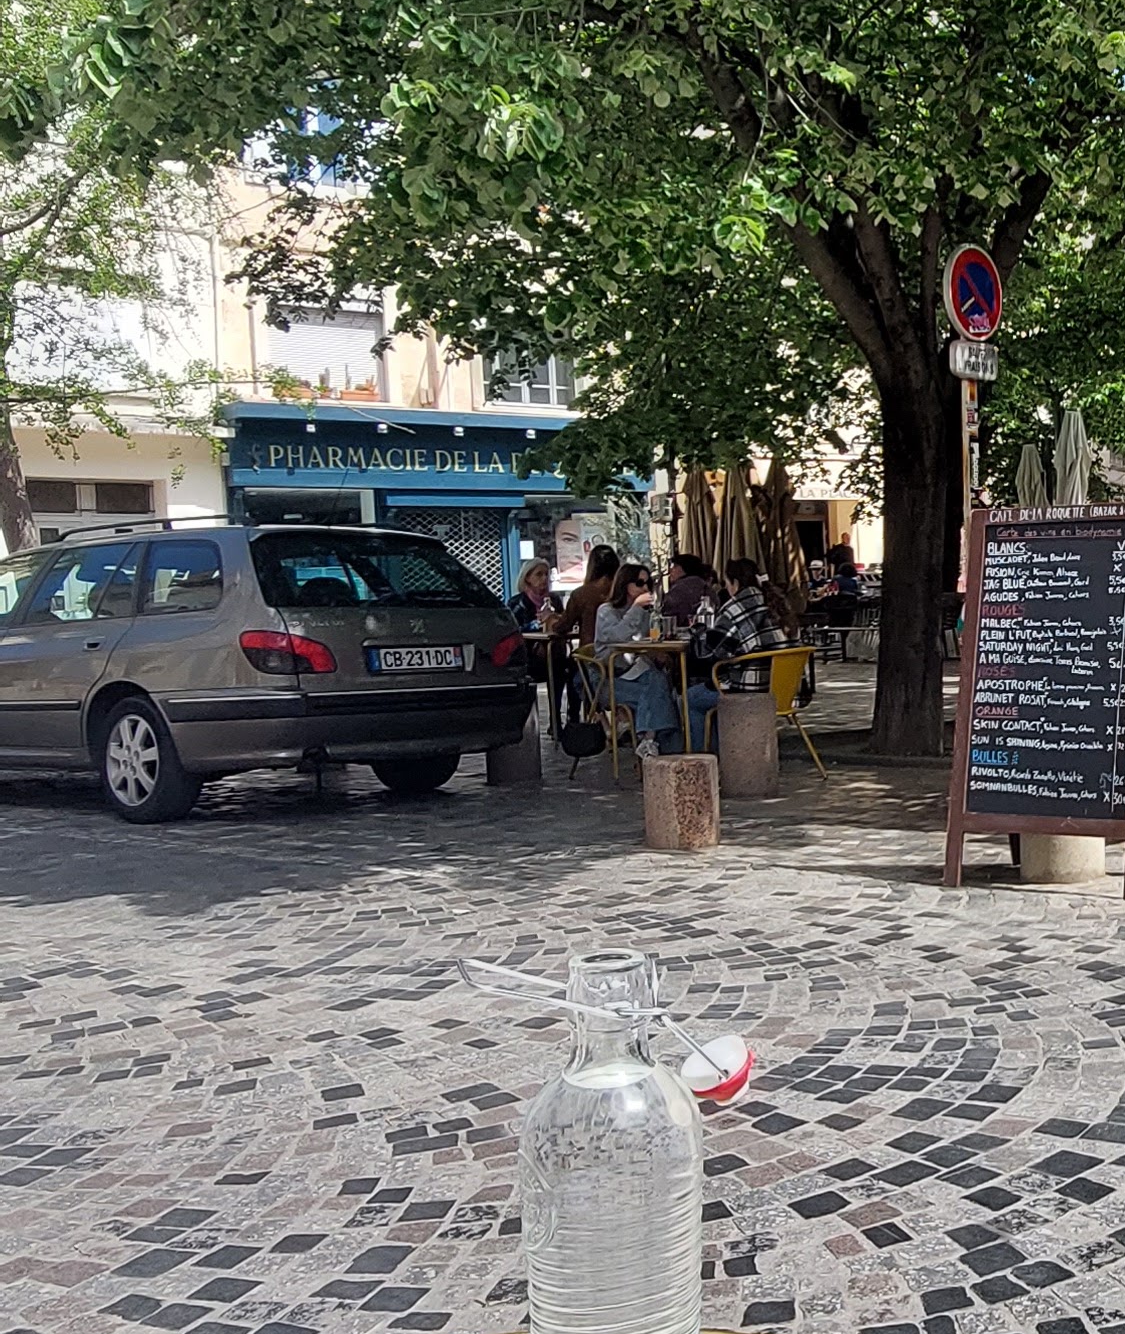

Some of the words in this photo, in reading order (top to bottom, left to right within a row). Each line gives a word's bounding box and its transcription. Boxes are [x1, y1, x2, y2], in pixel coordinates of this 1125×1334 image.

[268, 444, 427, 473] PHARMACIE
[434, 449, 468, 473] DE
[474, 451, 505, 474] LA
[800, 489, 815, 499] LA
[1046, 506, 1086, 520] ROQUETTE
[996, 527, 1019, 537] Carte
[1025, 527, 1038, 537] des
[982, 604, 1026, 616] ROUGES
[980, 629, 1005, 640] PLEIN
[979, 641, 1024, 654] SATURDAY
[383, 648, 453, 668] CB-231-DC
[979, 652, 987, 663] A
[974, 692, 1015, 704] ABRUNET
[975, 705, 1019, 717] ORANGE
[973, 718, 999, 730] SKIN
[971, 735, 990, 746] SUN
[995, 737, 1004, 746] IS
[972, 749, 1009, 764] BULLES
